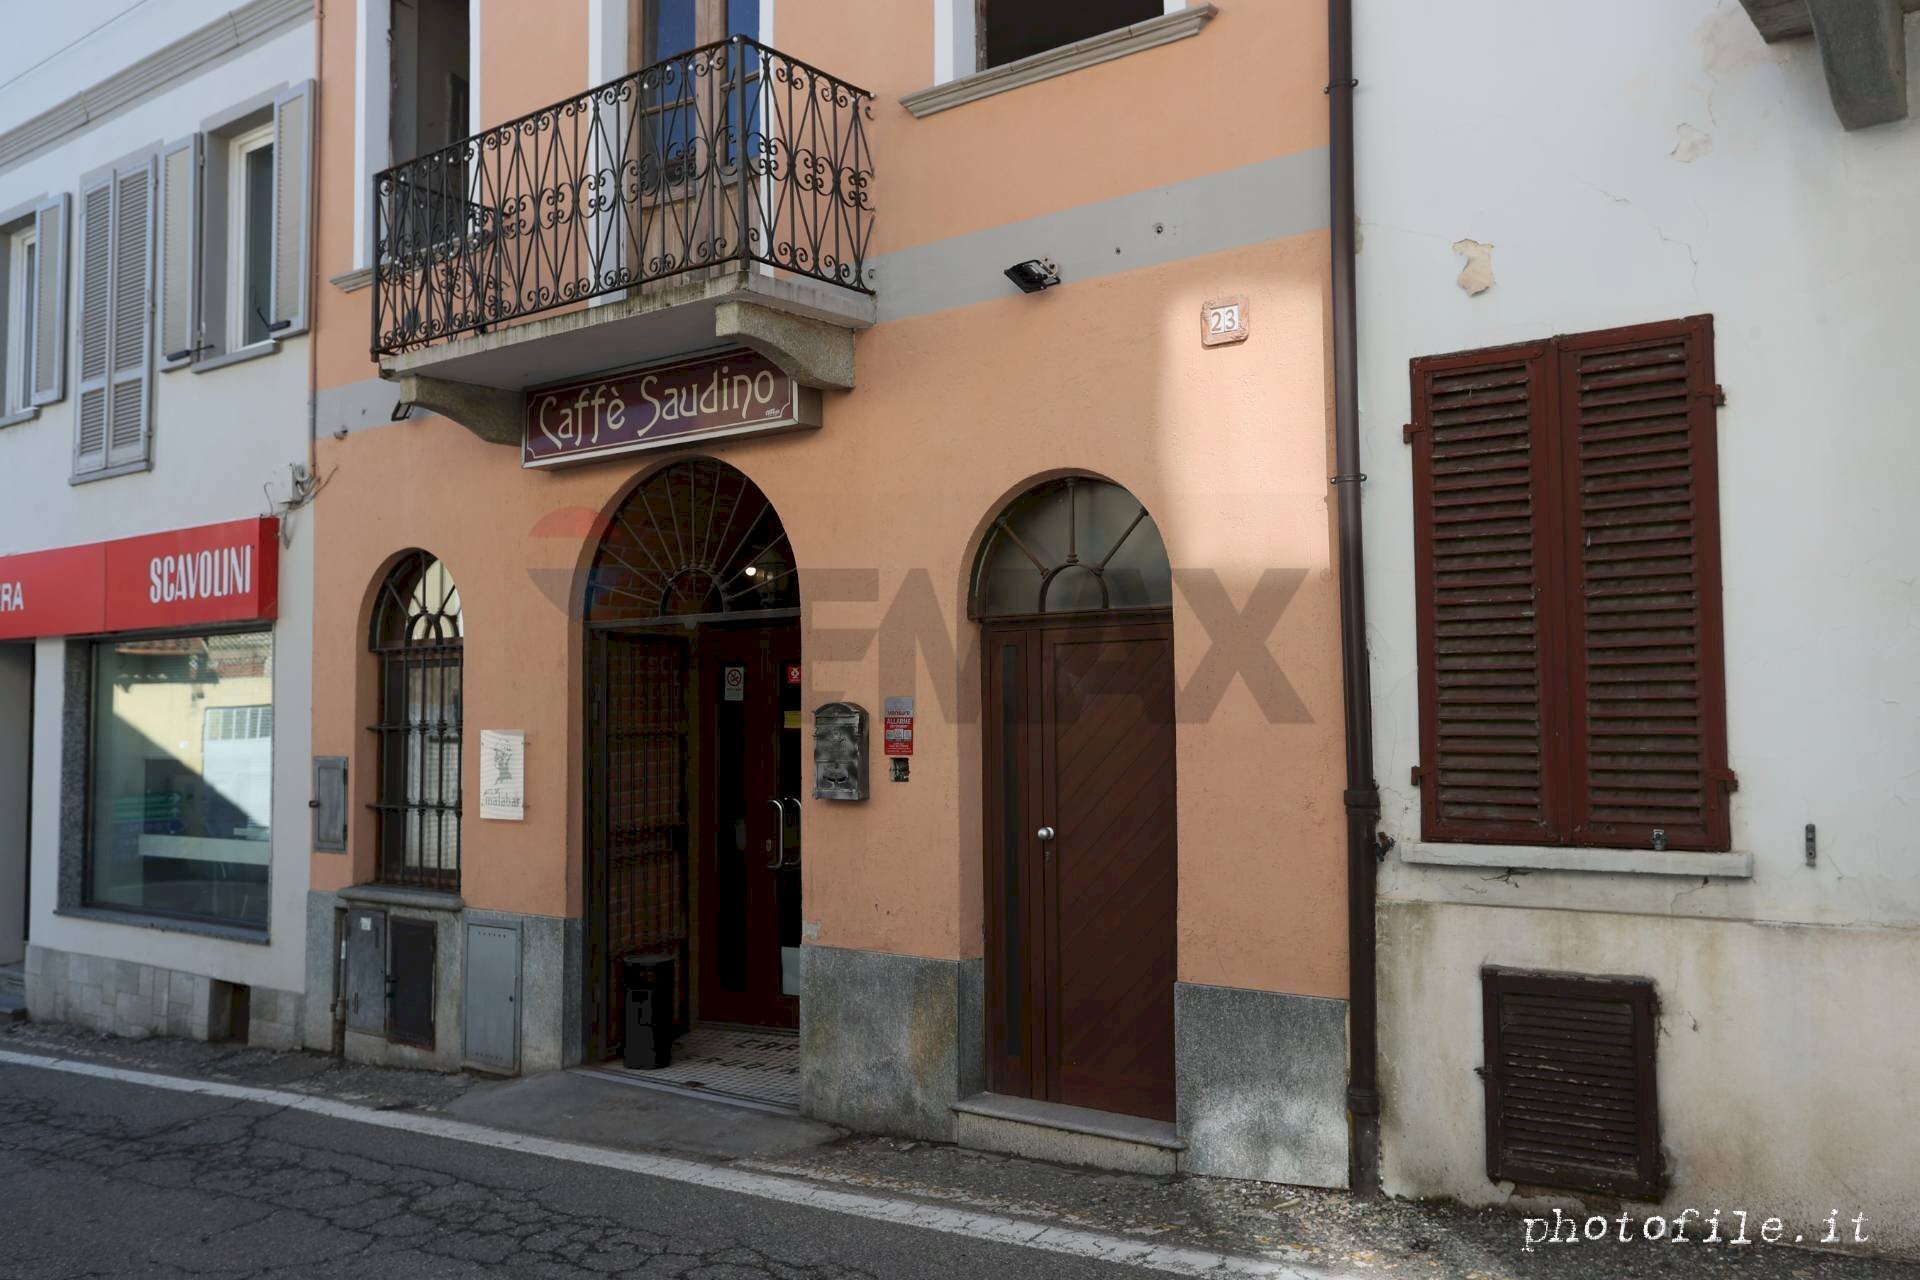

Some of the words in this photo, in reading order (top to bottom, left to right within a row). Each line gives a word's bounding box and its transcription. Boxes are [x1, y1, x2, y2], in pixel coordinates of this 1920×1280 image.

[1212, 310, 1235, 331] 23
[539, 384, 625, 450] Caffè
[637, 366, 775, 438] Saudino
[0, 581, 24, 612] RA
[149, 544, 251, 604] SCAVOLINI
